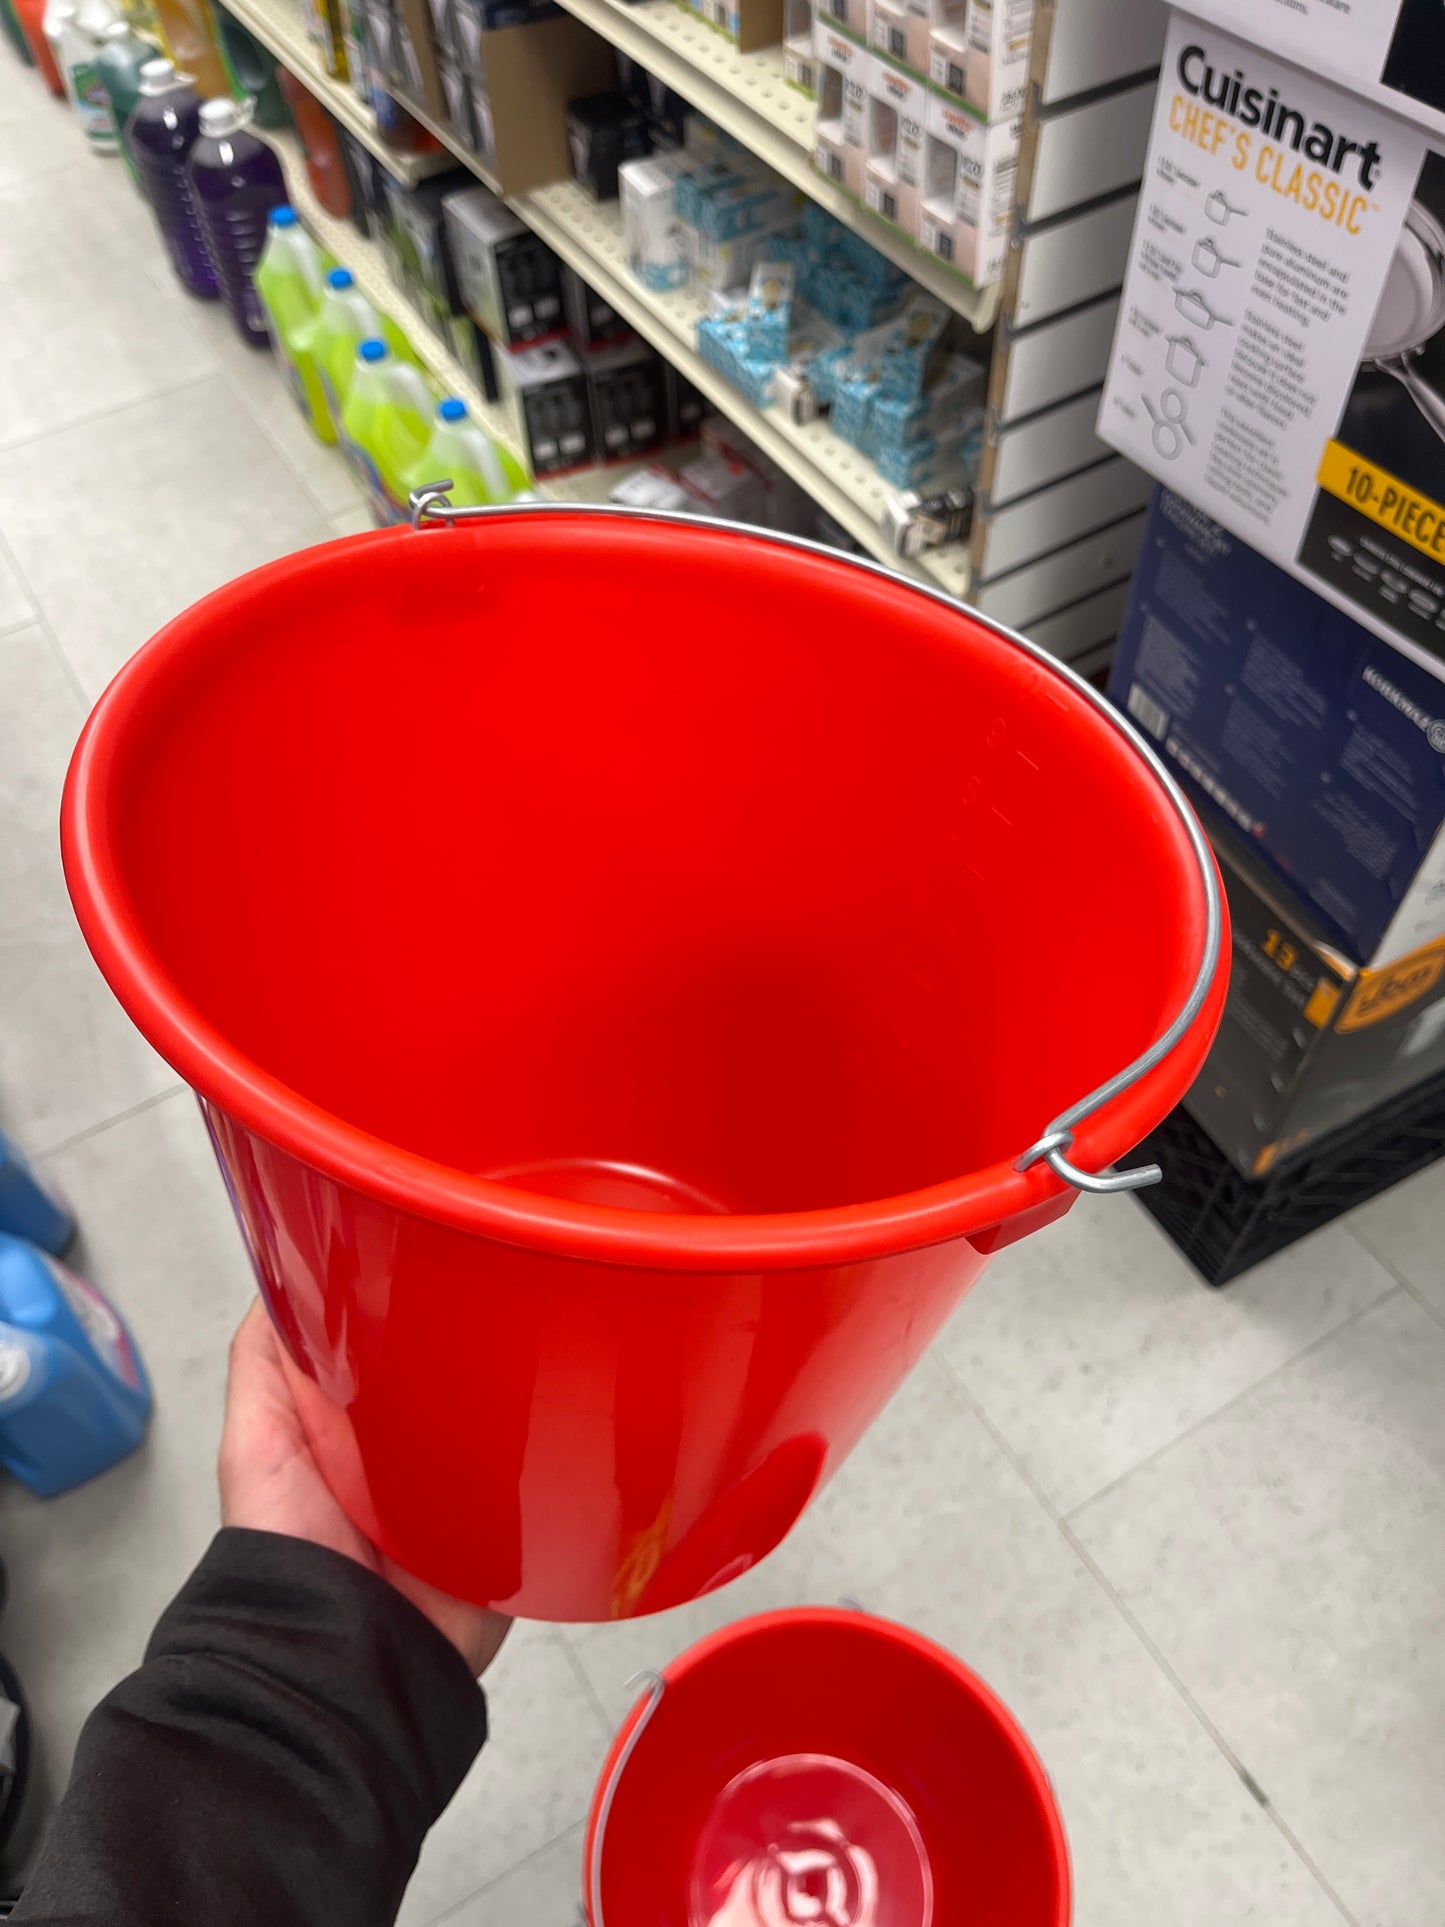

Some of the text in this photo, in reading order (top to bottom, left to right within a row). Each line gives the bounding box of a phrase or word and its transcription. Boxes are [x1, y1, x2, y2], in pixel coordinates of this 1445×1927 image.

[1169, 95, 1251, 171] CHEF'S
[1254, 145, 1368, 236] CLASSIC
[1177, 45, 1380, 192] Cuisinart
[1345, 467, 1445, 553] 10-PIECE
